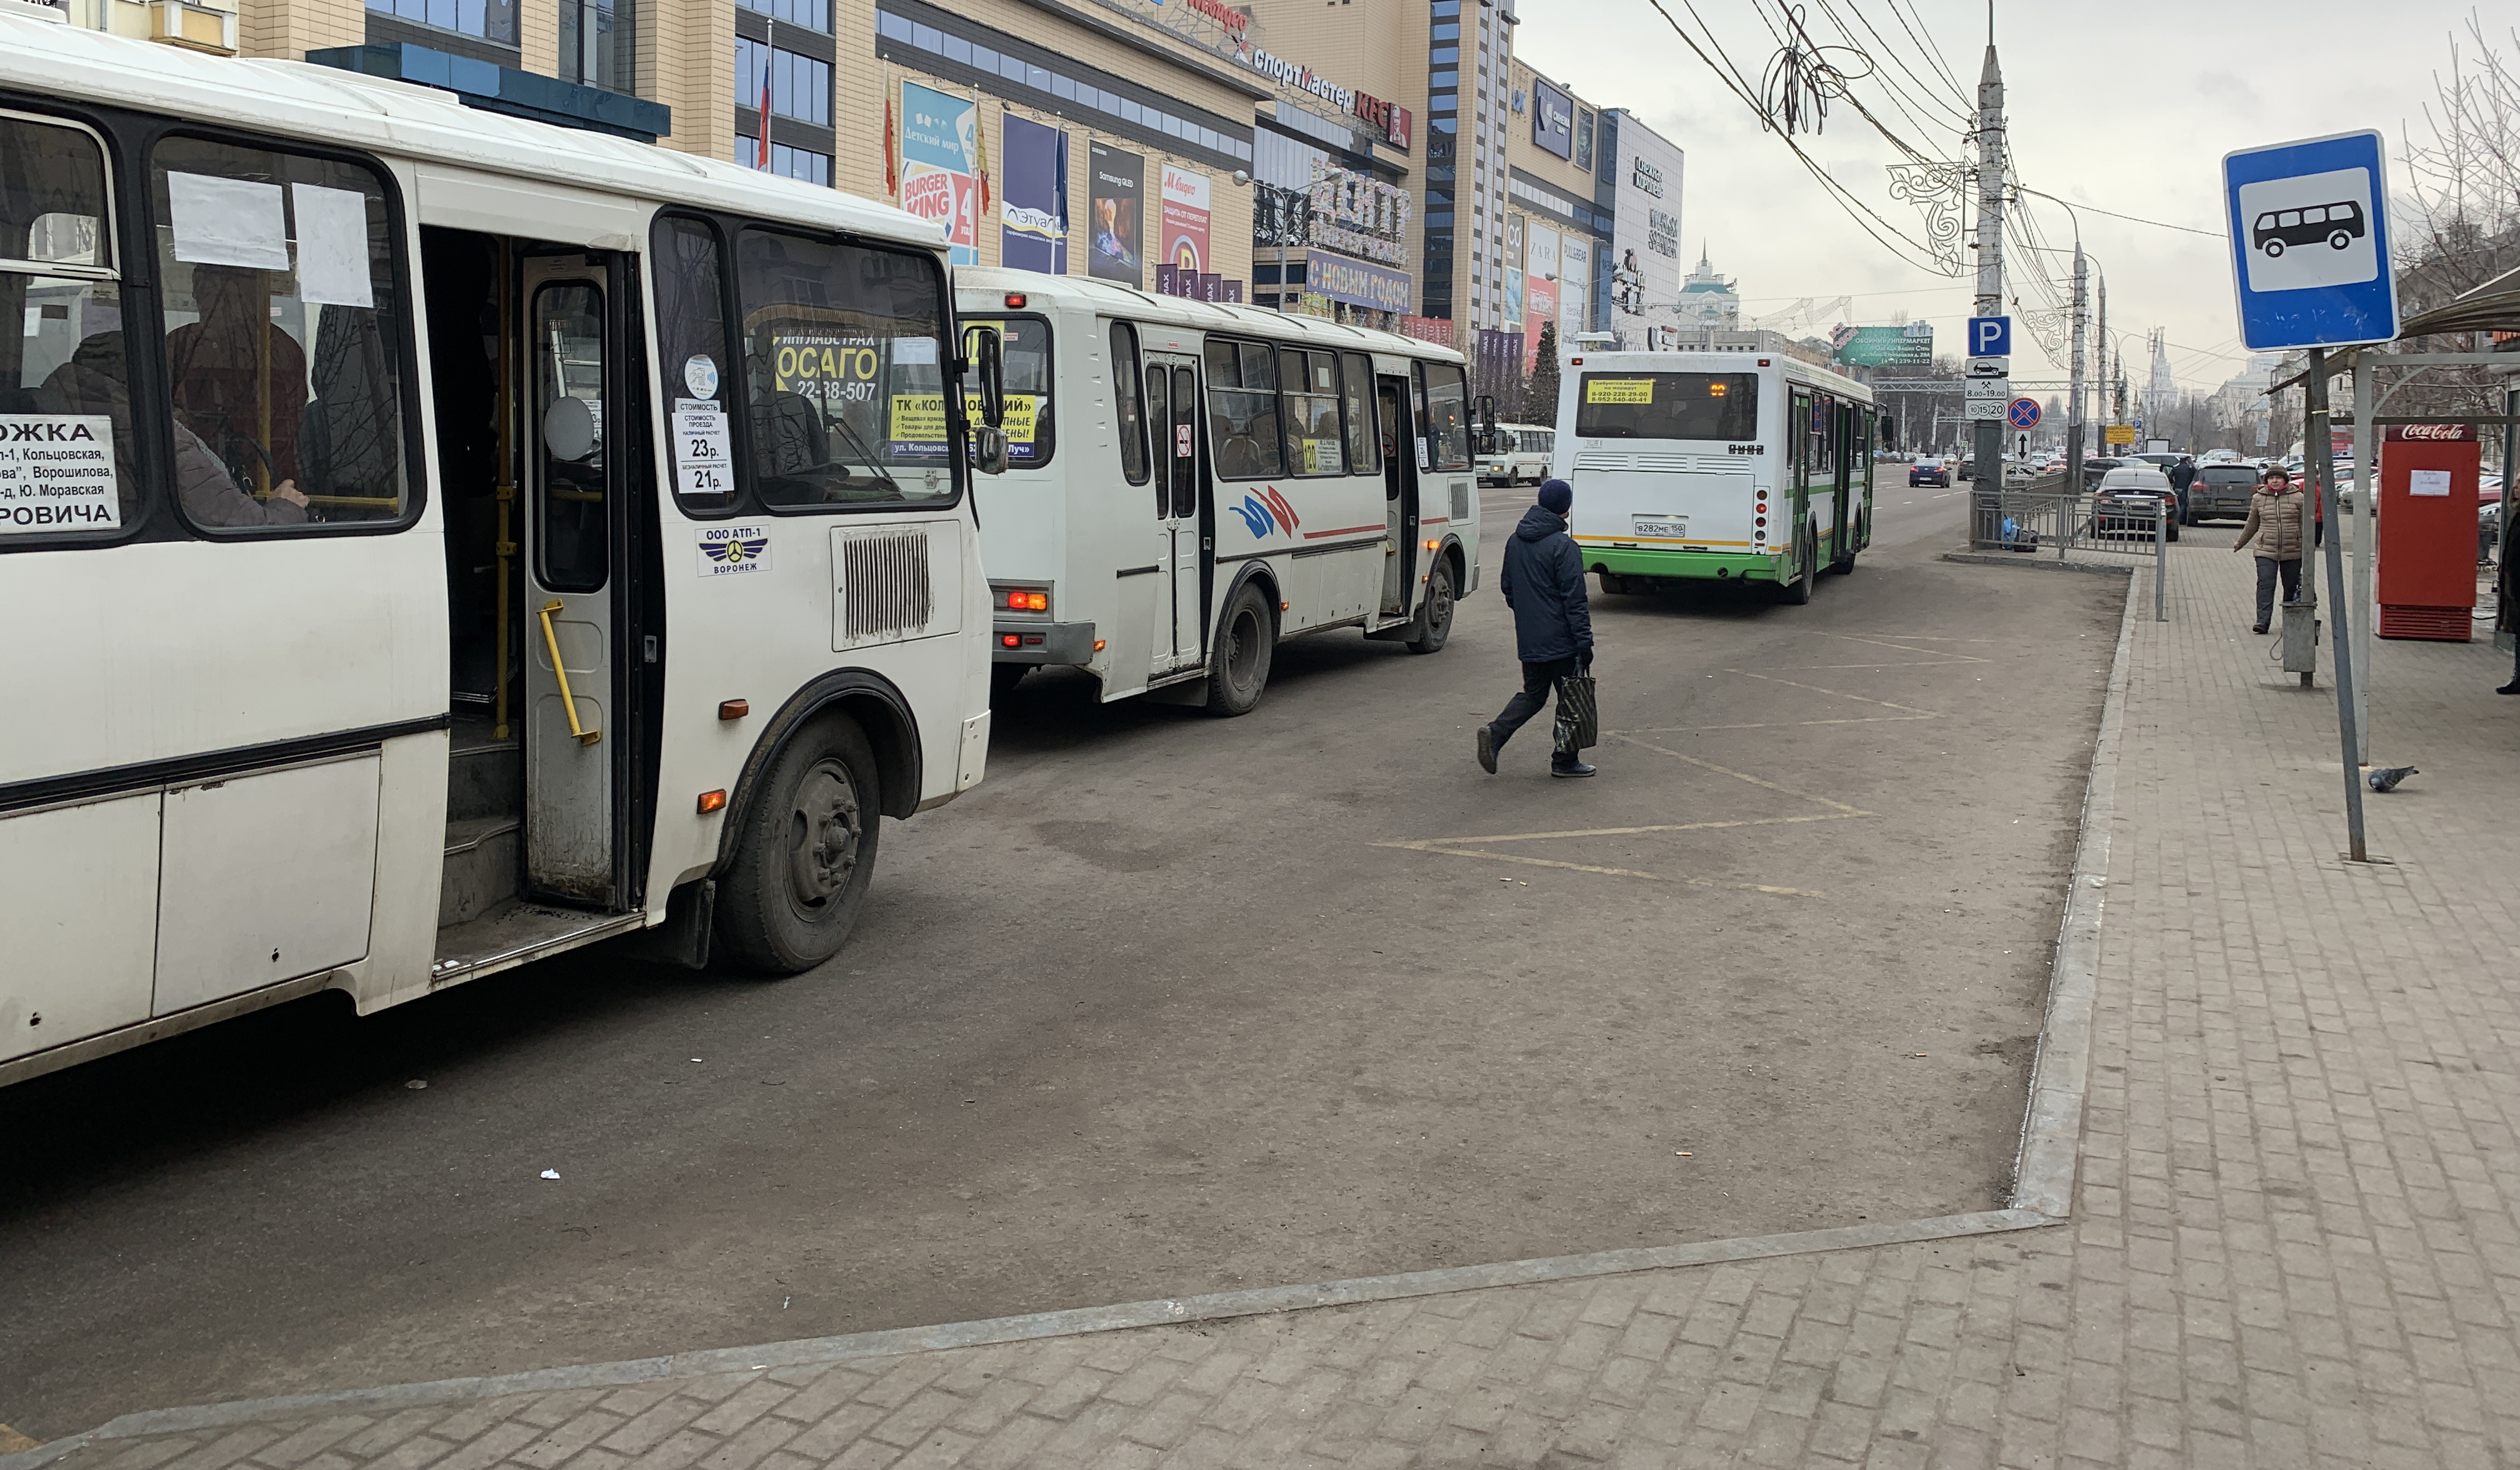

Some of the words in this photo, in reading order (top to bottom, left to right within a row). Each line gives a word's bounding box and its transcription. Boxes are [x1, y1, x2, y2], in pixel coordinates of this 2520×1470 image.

[1187, 0, 1248, 33] .видео
[1354, 90, 1389, 128] KFC
[904, 126, 940, 147] Детский
[941, 139, 959, 156] мир
[904, 173, 948, 202] BURGER
[1099, 171, 1122, 187] Samsung
[1122, 178, 1134, 188] QLED
[1164, 171, 1196, 197] М.видео
[906, 191, 949, 219] KING
[1163, 206, 1181, 216] ЗАЩИТА
[1181, 211, 1187, 219] ОТ
[1187, 212, 1208, 224] ПЕРЕПЛАТ
[961, 225, 971, 236] ЭТА
[1531, 241, 1557, 263] ZARA
[1564, 244, 1587, 263] PULL&BEAR
[1309, 259, 1319, 287] С
[1322, 262, 1369, 298] НОВЫМ
[1370, 274, 1409, 310] ГОДОМ
[1828, 321, 1846, 339] ВСЕ
[1832, 327, 1859, 351] ОБОИ
[1979, 321, 2002, 352] P
[778, 347, 878, 380] ОСАГО
[797, 380, 876, 401] 22-38-507
[896, 400, 912, 411] ТК
[1990, 406, 2003, 414] 20
[973, 417, 1031, 426] ДОПНЫЕ
[1003, 429, 1030, 438] ЕНЫ!
[2402, 424, 2466, 440] Coca-Cola
[22, 448, 105, 462] Кольцовская,
[894, 444, 906, 452] ул.
[1008, 444, 1030, 455] Луч»
[1304, 444, 1316, 469] 120
[33, 466, 113, 481] Ворошилова,
[19, 484, 36, 497] Ю.
[39, 484, 104, 499] Моравская
[0, 504, 112, 526] РОВИЧА
[706, 529, 729, 540] ООО
[732, 528, 761, 538] АТП-1
[714, 563, 758, 574] ВОРОНЕЖ
